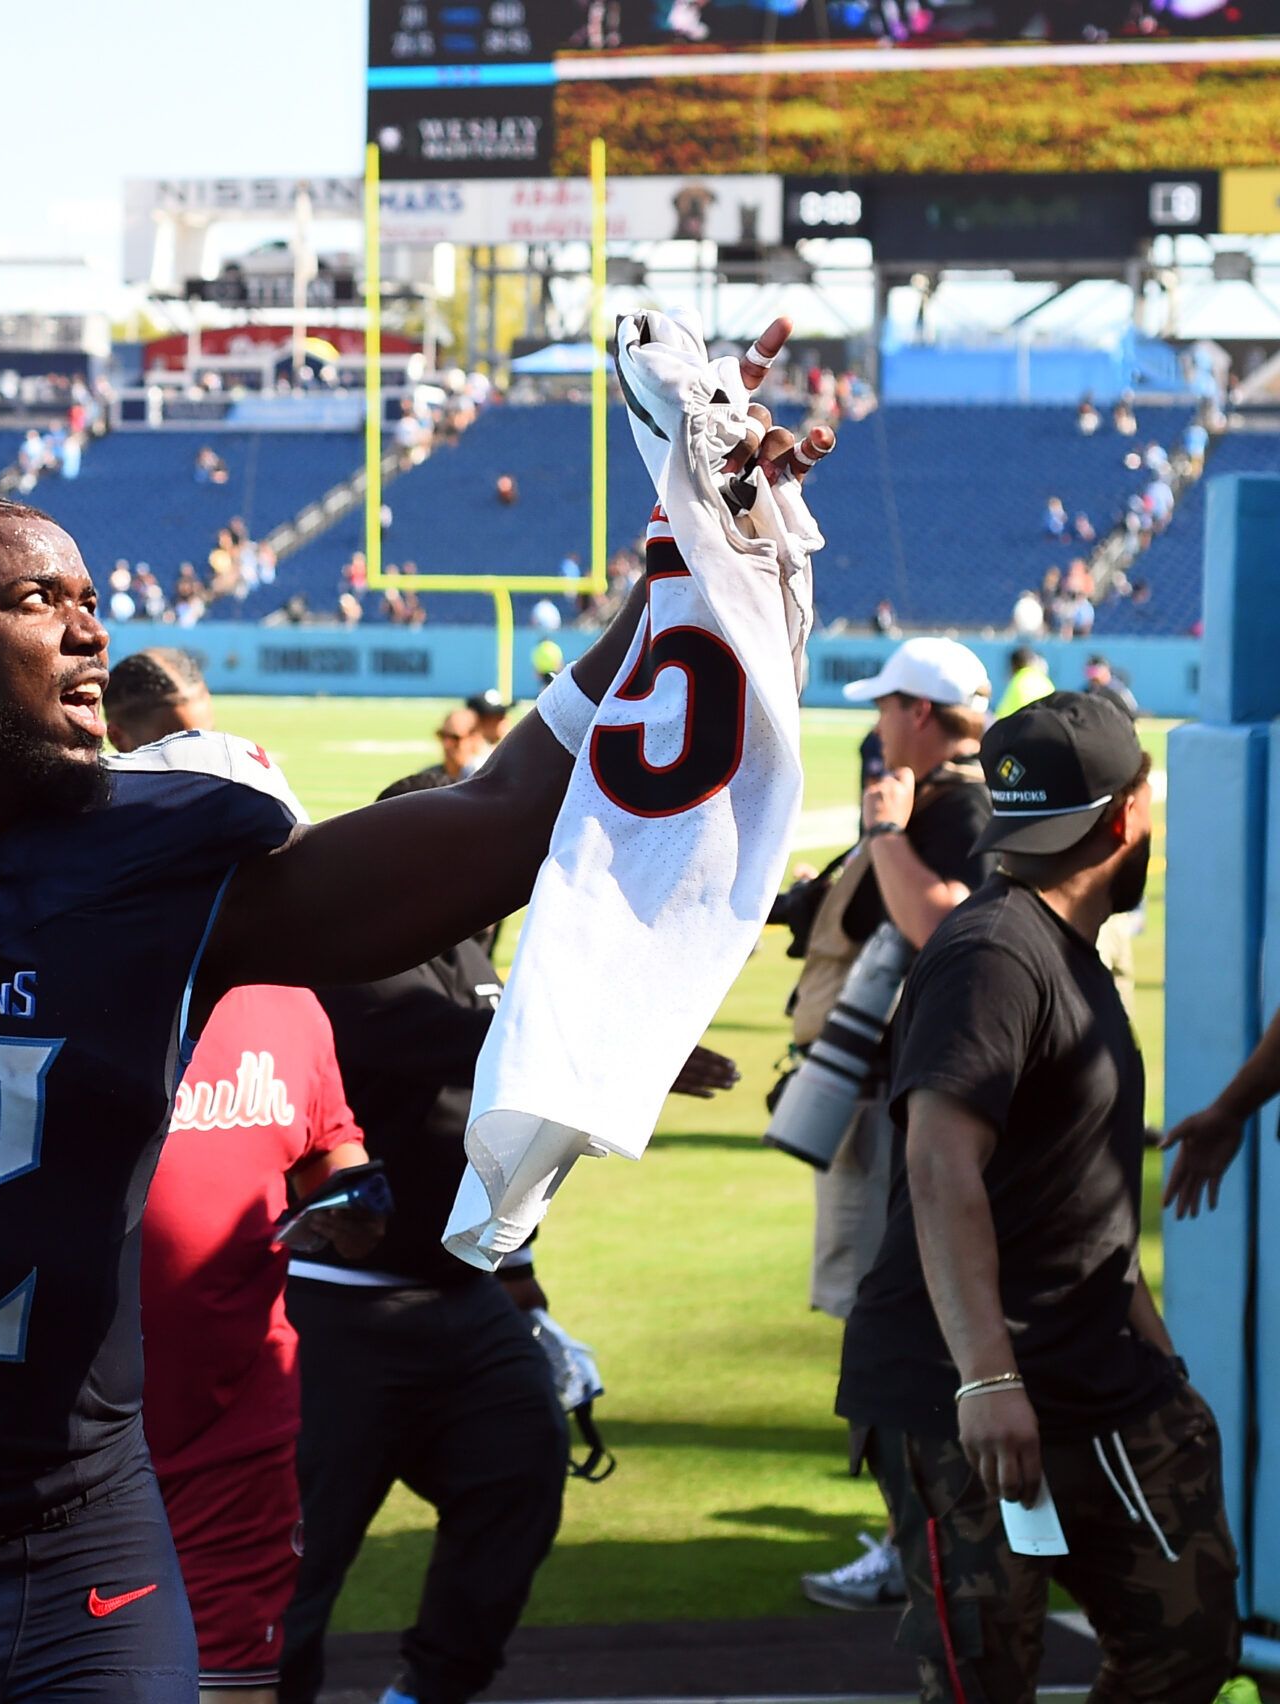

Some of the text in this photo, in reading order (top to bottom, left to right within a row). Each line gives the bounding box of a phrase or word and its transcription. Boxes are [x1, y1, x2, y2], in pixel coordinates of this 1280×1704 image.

[418, 117, 543, 139] WESLEY
[154, 179, 359, 209] NISSAN
[588, 536, 747, 818] 5
[169, 1051, 295, 1133] outh
